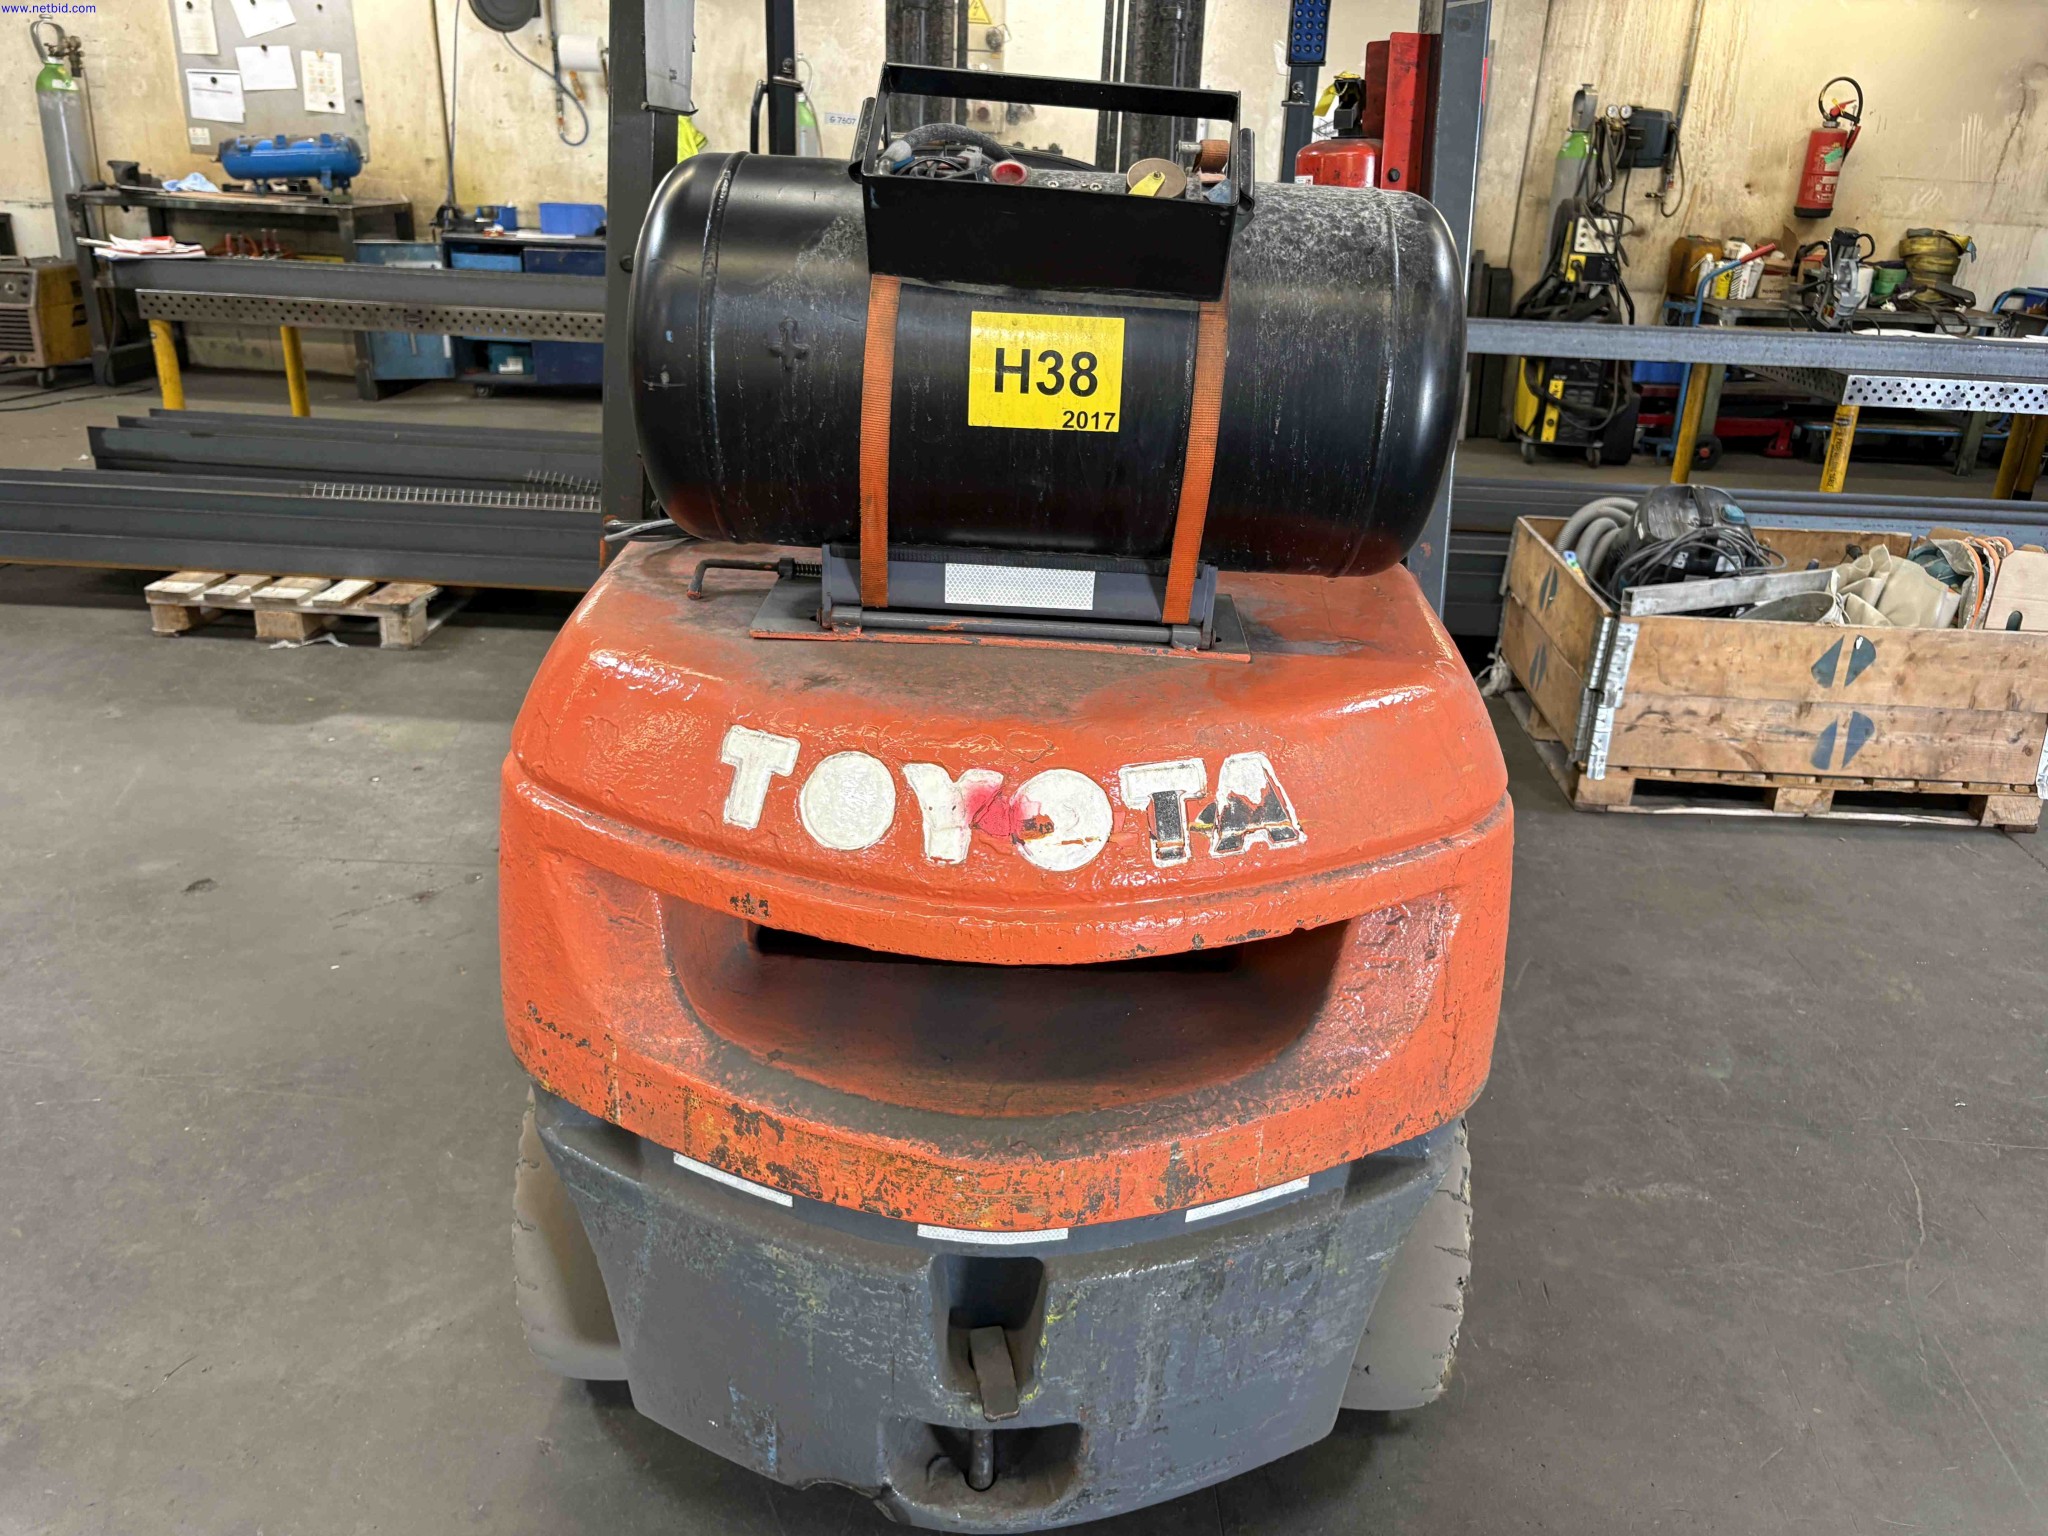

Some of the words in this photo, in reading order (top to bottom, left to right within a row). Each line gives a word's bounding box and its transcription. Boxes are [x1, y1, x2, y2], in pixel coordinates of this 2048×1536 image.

[994, 347, 1099, 397] H38
[1061, 410, 1117, 431] 2017
[721, 724, 1307, 872] TOYOTA
